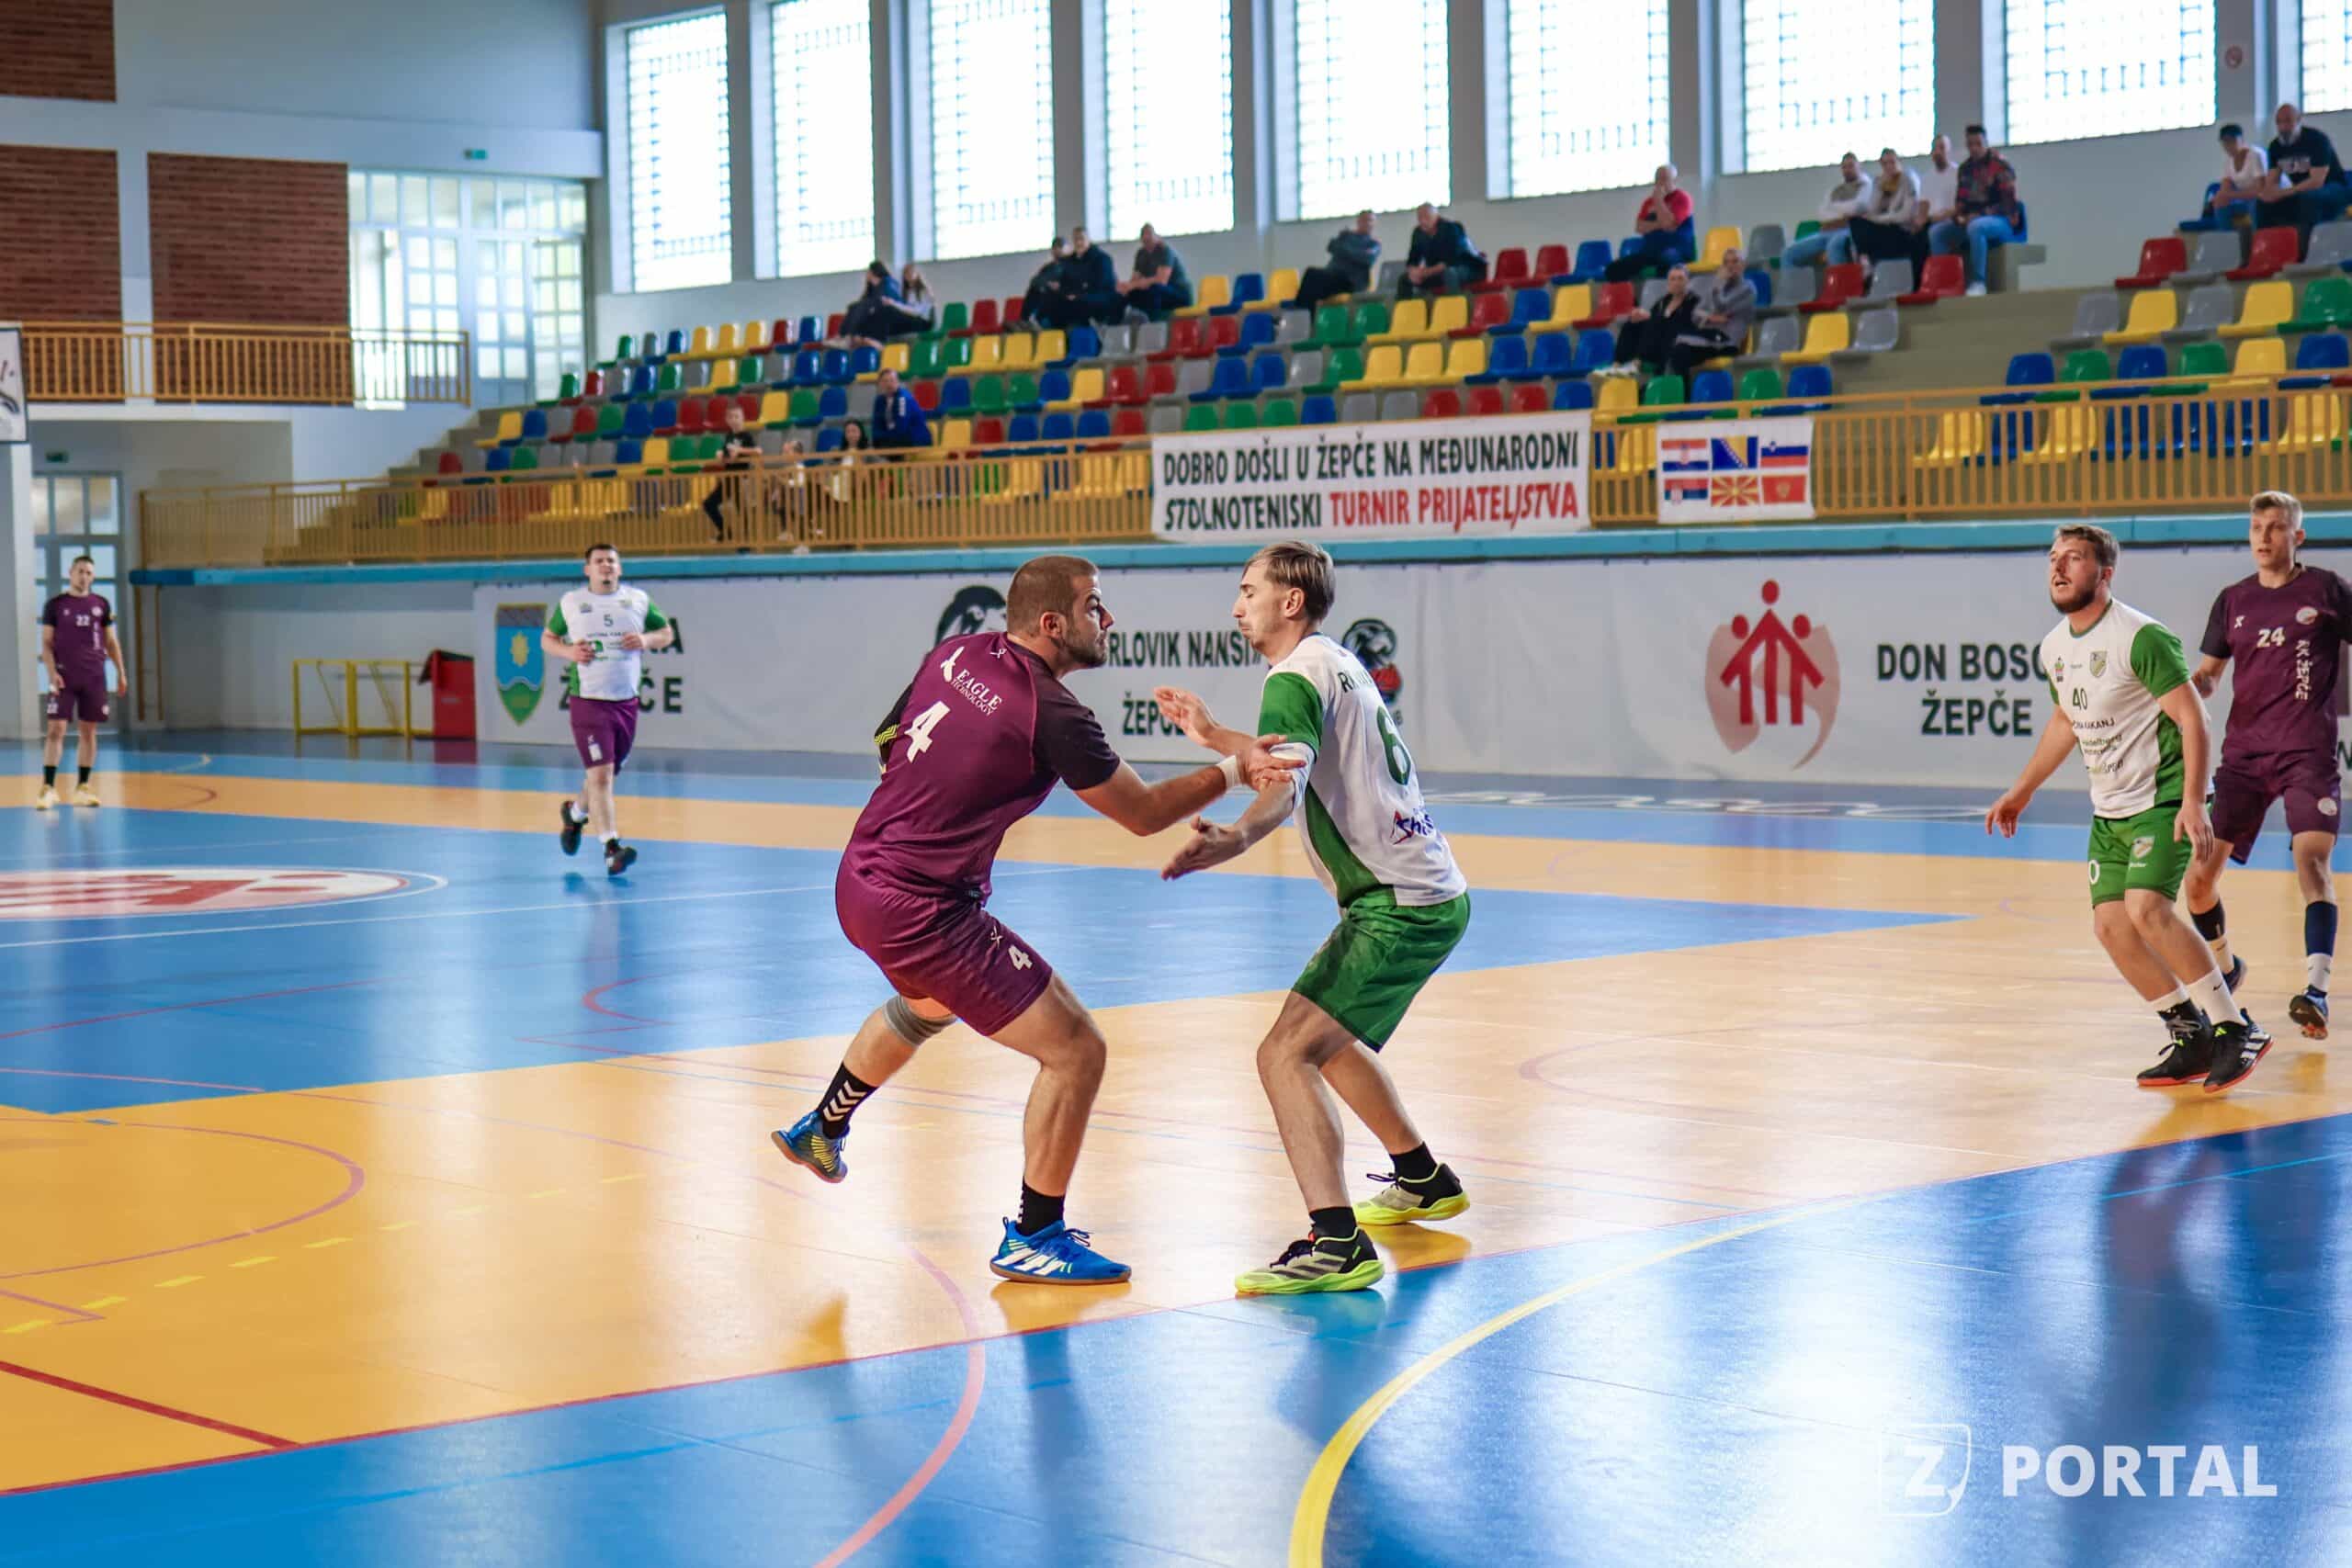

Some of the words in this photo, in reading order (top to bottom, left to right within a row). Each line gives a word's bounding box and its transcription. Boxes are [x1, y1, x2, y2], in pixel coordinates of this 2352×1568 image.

[1163, 450, 1229, 486] DOBRO
[1235, 436, 1289, 483] DOŠLI
[1297, 446, 1310, 479] U
[1316, 431, 1376, 479] ŽEPČE
[1384, 440, 1412, 477] NA
[1419, 431, 1579, 475] MEĐUNARODNI
[1164, 492, 1322, 531] STOLNOTENISKI
[1329, 488, 1410, 527] TURNIR
[1418, 481, 1579, 533] PRIJATELJSTVA
[75, 615, 90, 626] 22
[604, 614, 614, 626] 5
[2256, 626, 2286, 648] 24
[1108, 631, 1182, 667] RLOVIK
[1877, 643, 1947, 682] DON
[1960, 643, 2050, 682] BOSC
[956, 668, 1002, 710] EAGLE
[2072, 687, 2087, 710] 40
[904, 701, 951, 763] 4
[1921, 689, 2033, 737] ŽEPČE
[1376, 705, 1412, 786] 6
[1008, 944, 1033, 971] 4
